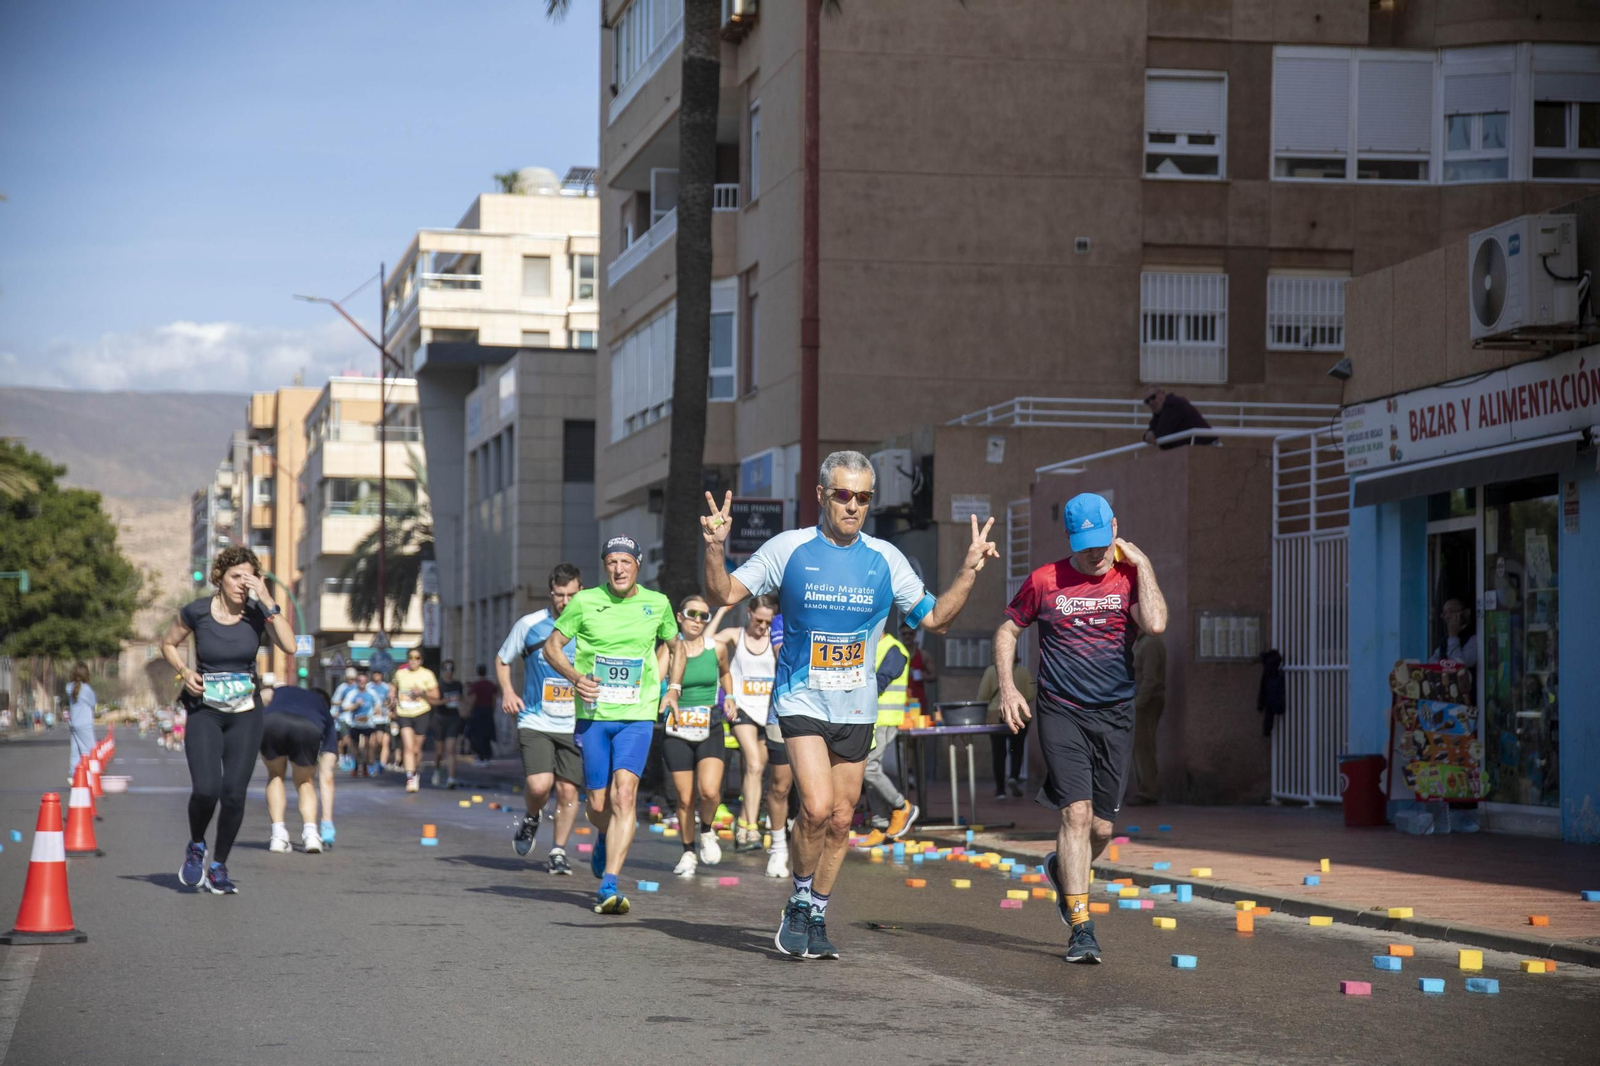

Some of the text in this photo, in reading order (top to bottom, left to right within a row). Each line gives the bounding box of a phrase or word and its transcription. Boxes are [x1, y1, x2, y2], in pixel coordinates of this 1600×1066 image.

[1408, 356, 1600, 442] BAZAR Y ALIMENTACIÓN
[732, 504, 781, 513] THE PHONE
[741, 528, 771, 537] DRONE
[805, 583, 875, 595] Medio Maratón
[804, 591, 873, 605] Almería 2025
[804, 602, 827, 610] RAMÓN
[819, 642, 862, 661] 1532
[609, 667, 629, 680] 99
[552, 686, 575, 697] 976
[746, 681, 773, 693] 1015
